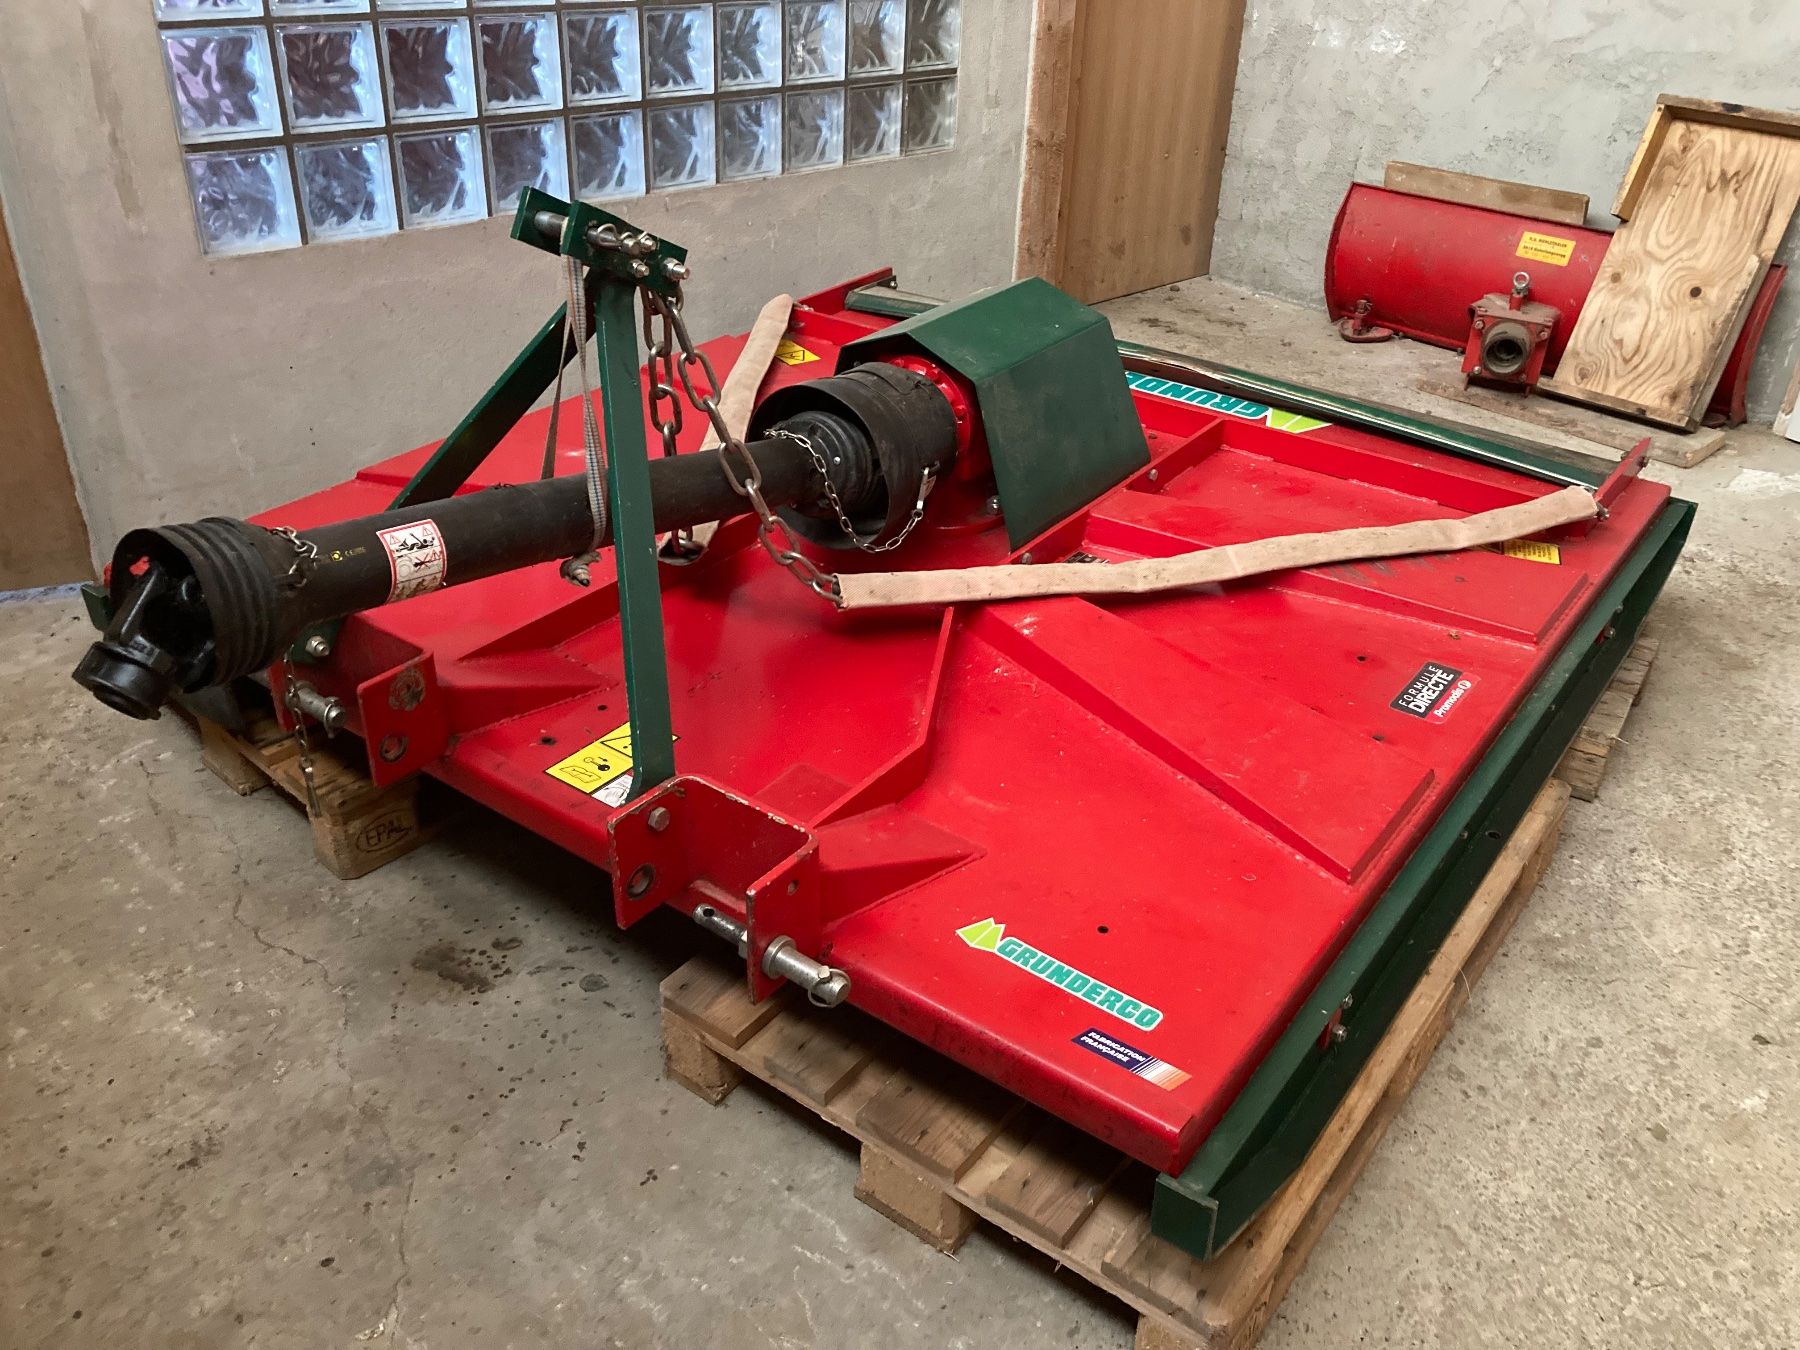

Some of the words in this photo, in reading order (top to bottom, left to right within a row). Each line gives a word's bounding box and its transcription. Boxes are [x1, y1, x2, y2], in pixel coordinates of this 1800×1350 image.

[1398, 665, 1439, 707] FORMULE
[1407, 668, 1455, 713] DIRECTE
[1433, 686, 1465, 718] Promodis
[996, 937, 1162, 1029] GRUNDERCO
[1080, 1035, 1130, 1063] FRANÇAISE
[1087, 1031, 1147, 1062] FABRICATION
